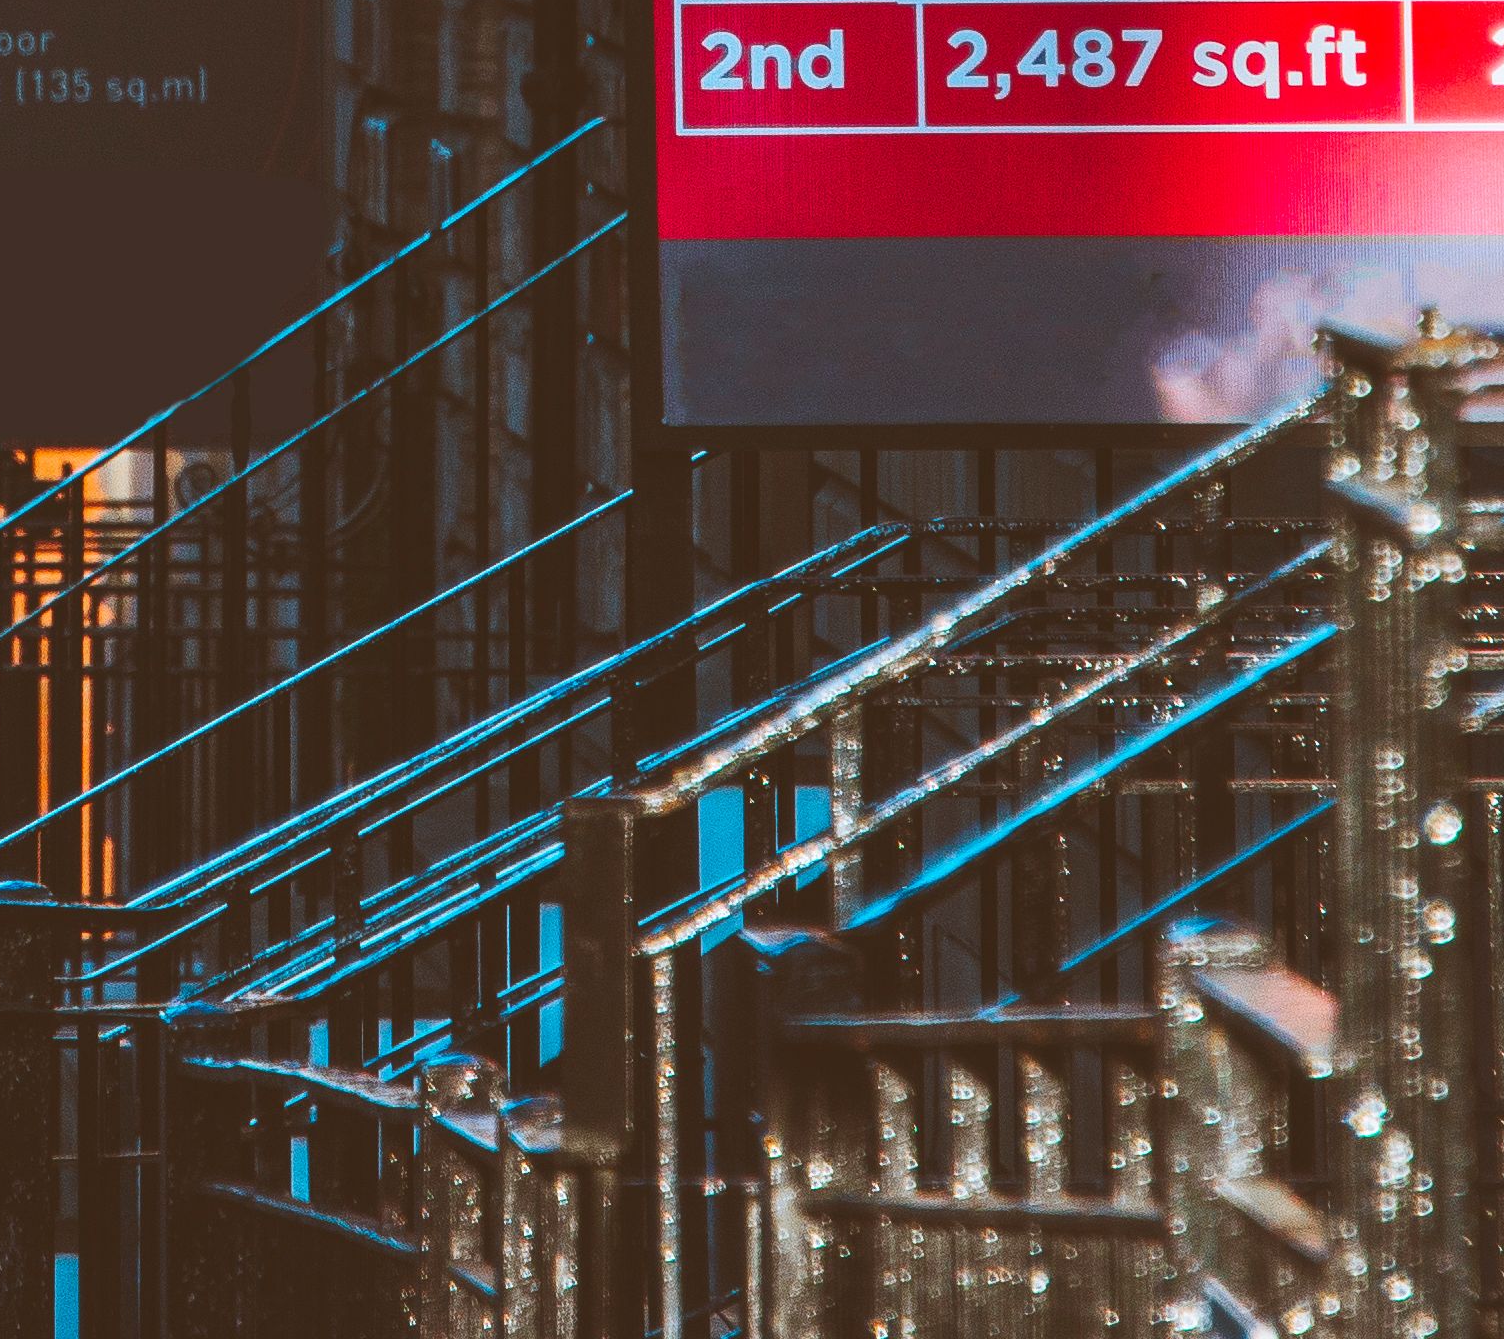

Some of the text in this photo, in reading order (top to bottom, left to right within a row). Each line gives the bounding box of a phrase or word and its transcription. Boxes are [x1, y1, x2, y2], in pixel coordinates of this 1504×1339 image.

[699, 28, 846, 91] 2nd
[945, 28, 1164, 101] 2,487
[1192, 24, 1368, 101] sq.ft
